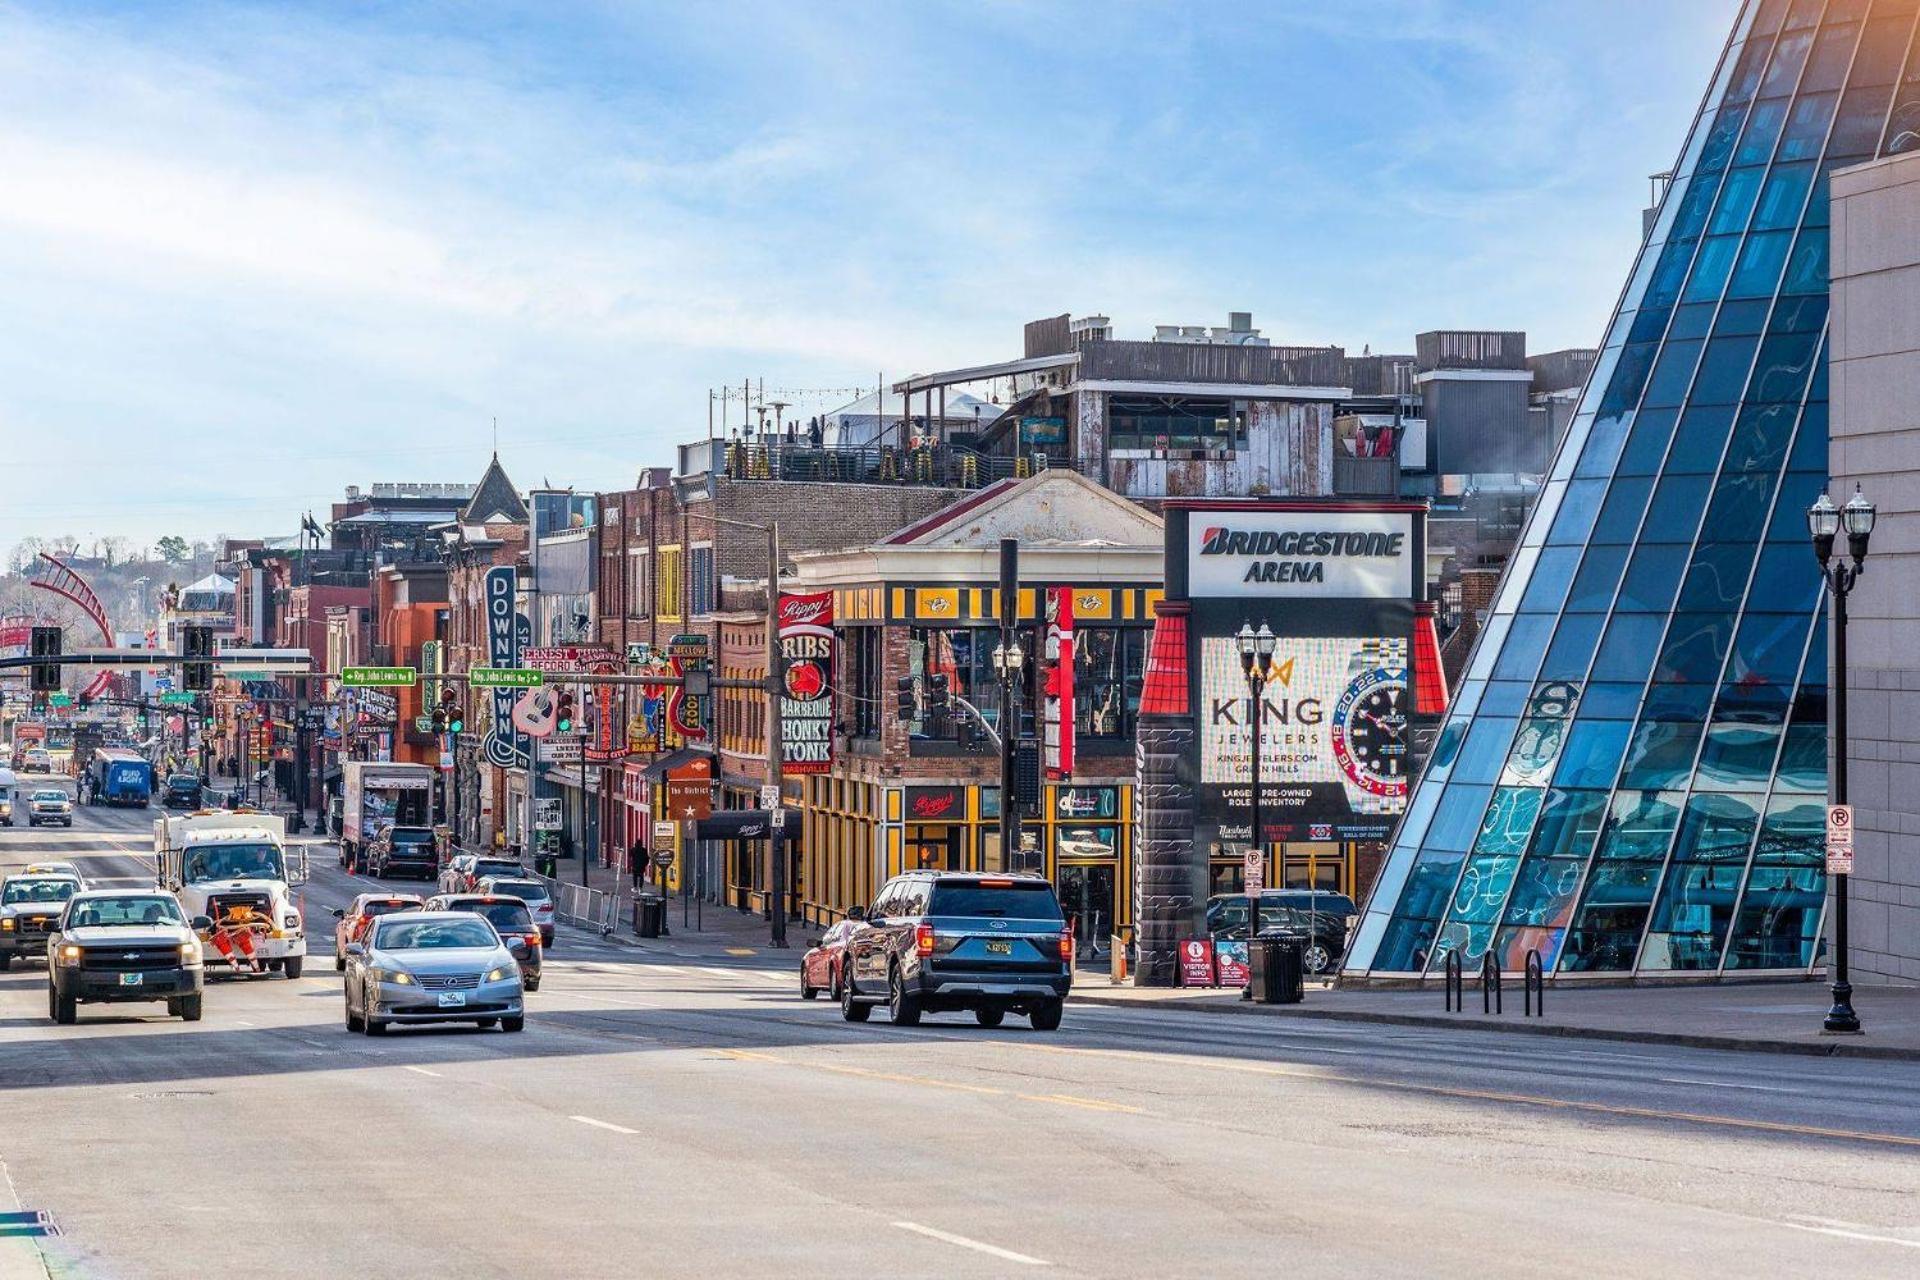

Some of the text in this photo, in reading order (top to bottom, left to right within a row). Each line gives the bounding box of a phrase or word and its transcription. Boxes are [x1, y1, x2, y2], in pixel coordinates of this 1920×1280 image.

[1200, 527, 1404, 556] BRIDGESTONE
[1243, 561, 1323, 583] ARENA
[781, 636, 831, 659] RIBS
[526, 648, 570, 660] ERNEST
[531, 661, 571, 672] RECORD
[367, 670, 380, 681] John
[380, 670, 397, 681] Lewis
[486, 671, 499, 681] John
[500, 671, 516, 681] Lewis
[685, 658, 699, 726] MROOM
[781, 696, 832, 717] BARBEQUE
[1212, 698, 1323, 726] KING
[781, 719, 831, 741] HONKY
[781, 741, 831, 762] TONK
[1217, 755, 1318, 763] KINGJEELERS.COM
[121, 769, 140, 777] BUD
[782, 764, 830, 774] NASHVILLE
[1235, 765, 1299, 774] GRN HILLS
[117, 776, 143, 784] LIGHT
[1261, 789, 1313, 798] PRE-OWNED
[1228, 798, 1307, 807] ROLE INVENTORY
